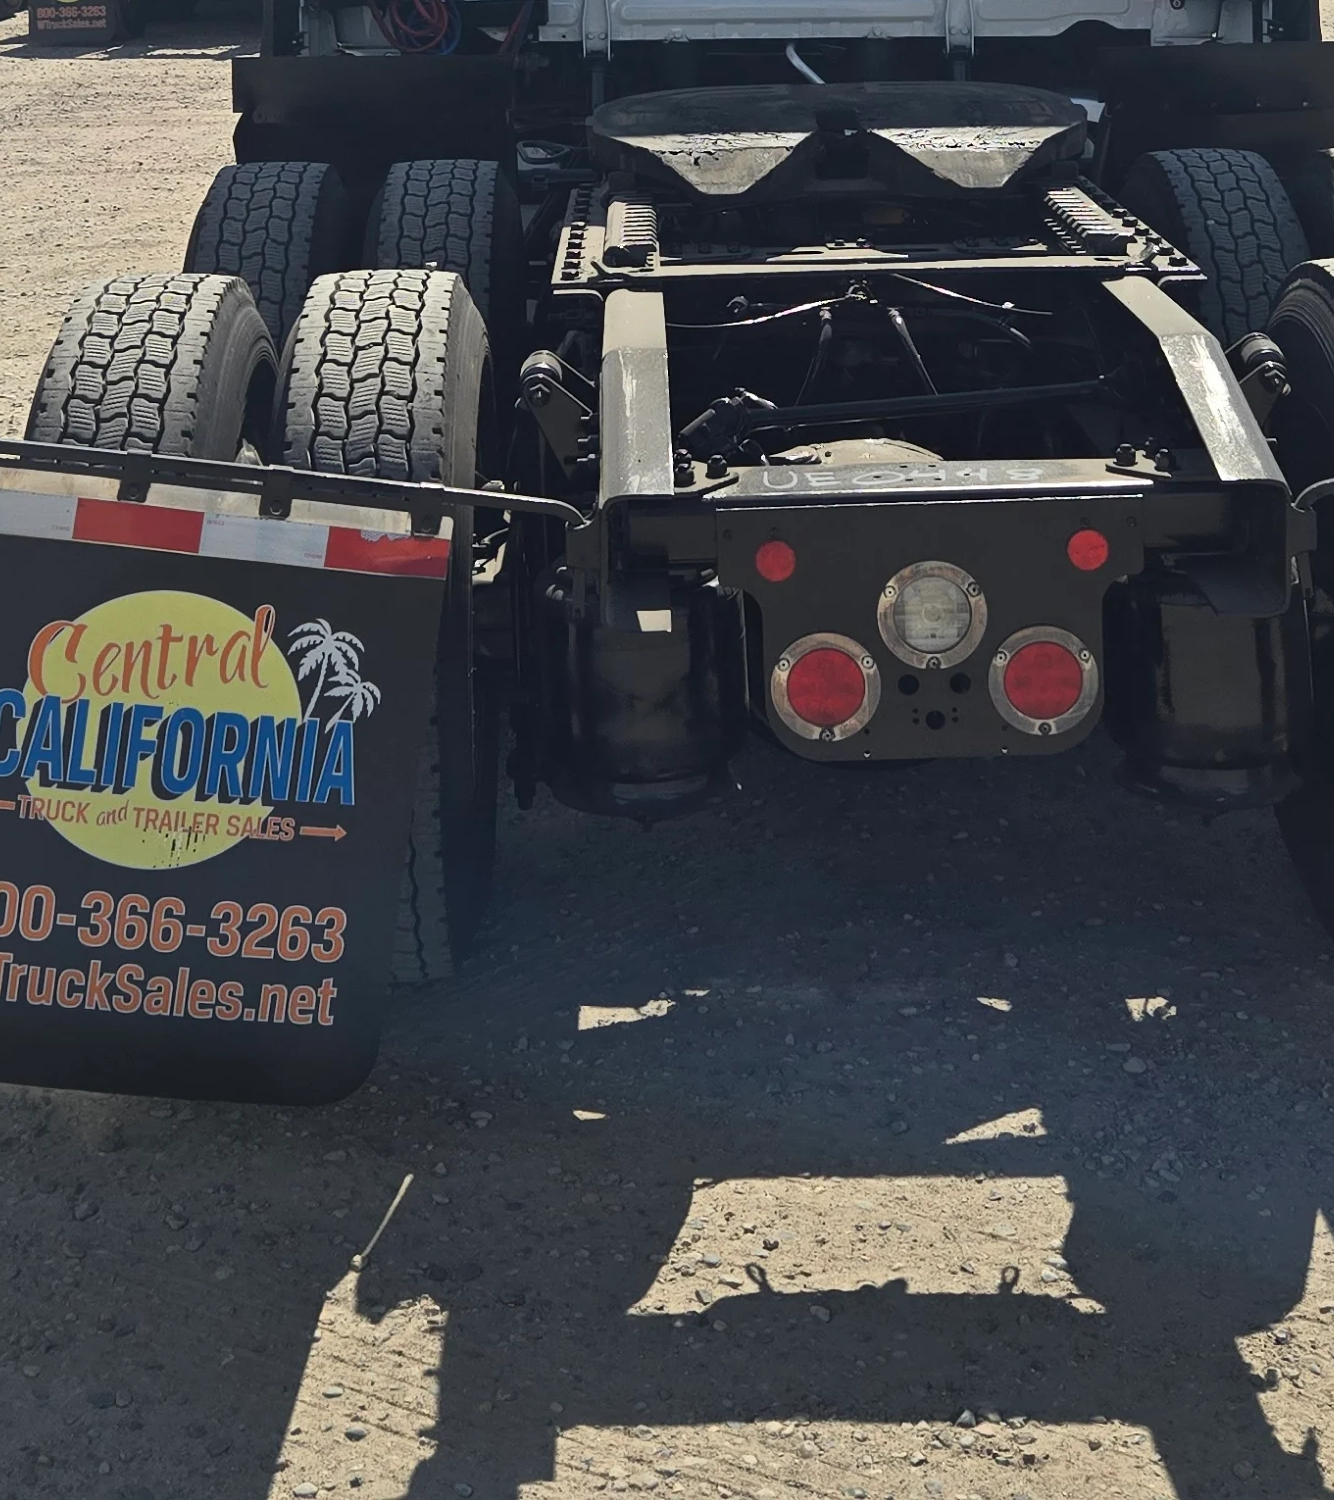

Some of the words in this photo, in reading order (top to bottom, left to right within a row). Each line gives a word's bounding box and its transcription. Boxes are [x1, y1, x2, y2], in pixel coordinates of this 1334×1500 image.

[27, 604, 276, 704] Central
[18, 795, 91, 825] TRUCK
[96, 800, 128, 827] and
[133, 807, 220, 836] TRAILER
[226, 815, 296, 842] SALES
